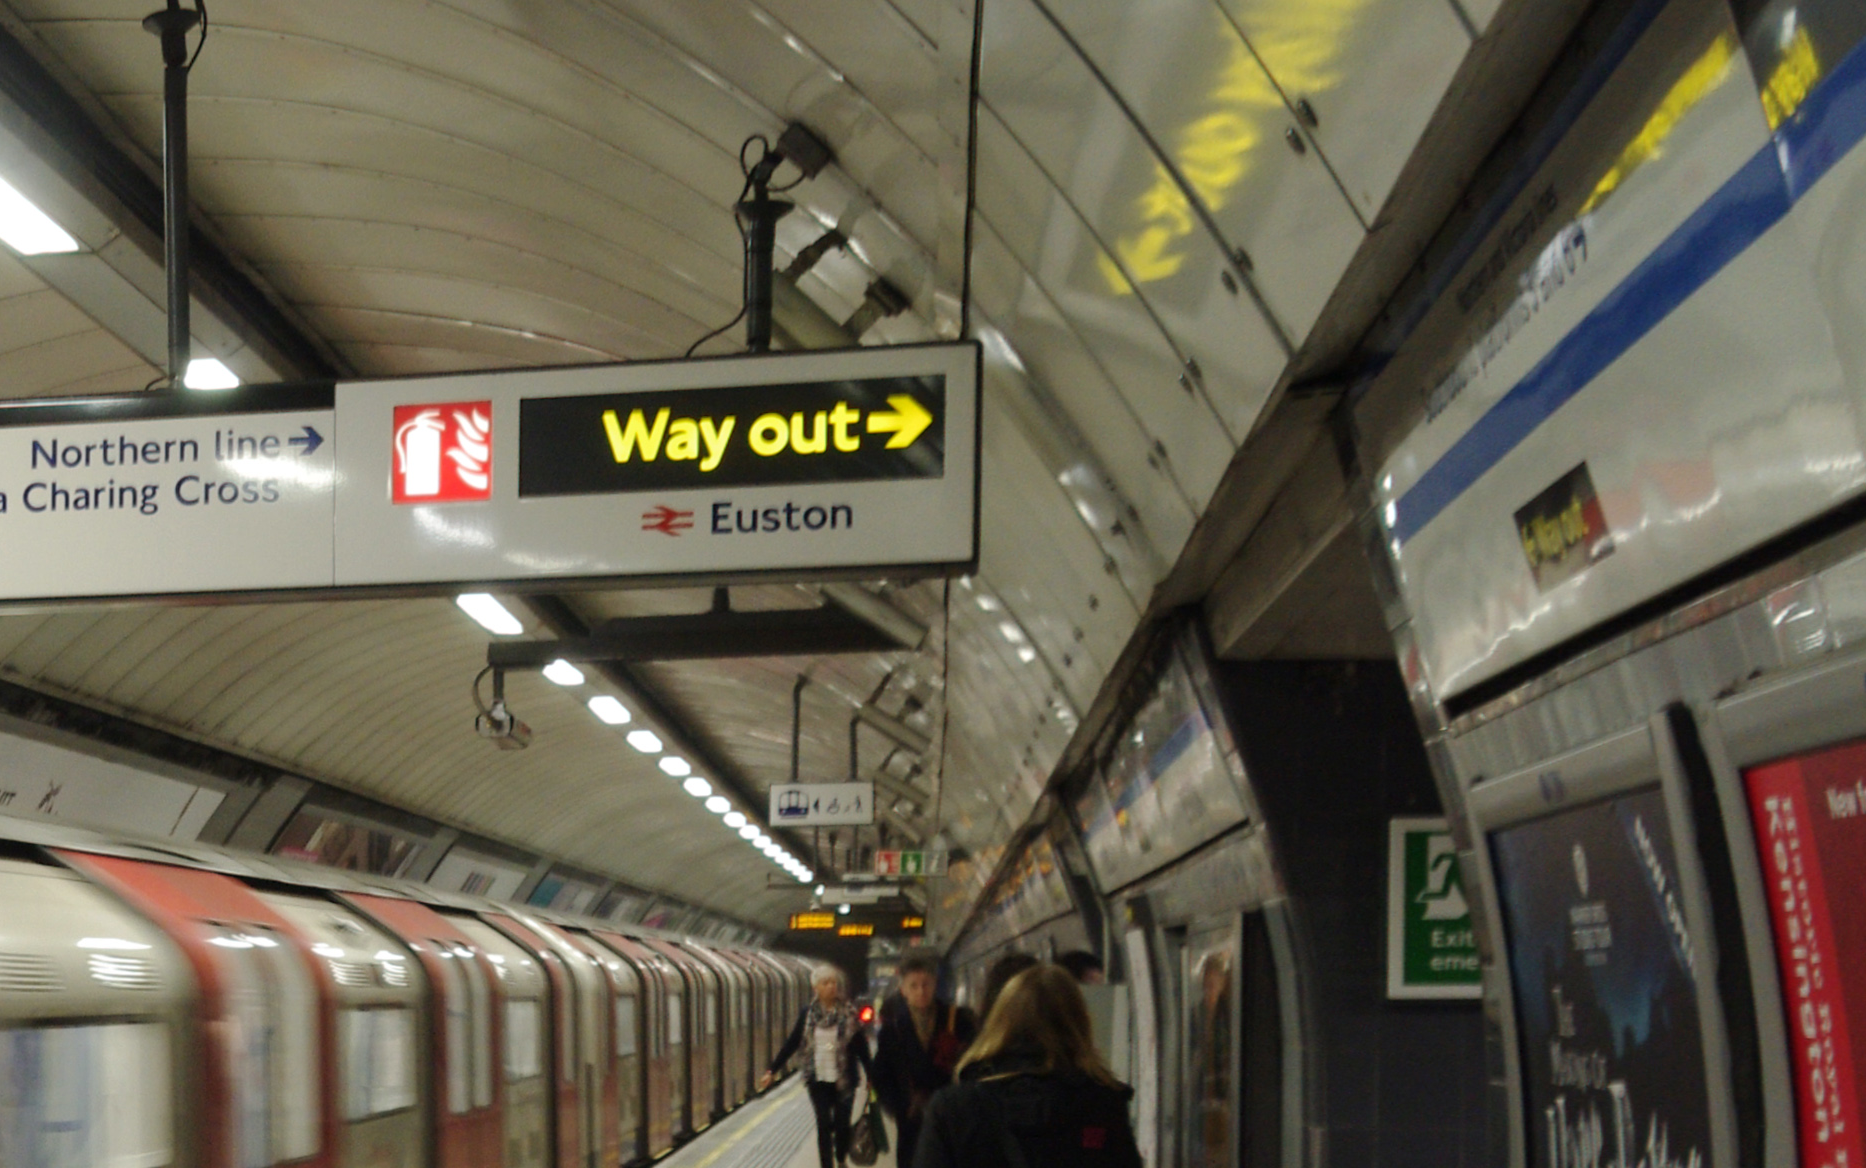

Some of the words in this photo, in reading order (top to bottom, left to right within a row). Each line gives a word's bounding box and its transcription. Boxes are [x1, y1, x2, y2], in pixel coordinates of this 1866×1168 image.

[31, 436, 199, 469] Northern
[214, 430, 281, 461] line
[601, 406, 736, 472] Way
[748, 402, 860, 456] out
[22, 479, 159, 515] Charing
[174, 475, 280, 506] Cross
[711, 501, 853, 534] Euston
[1431, 930, 1475, 948] Exit
[1764, 795, 1830, 1143] Kensington
[1782, 797, 1823, 990] Historic
[1818, 1002, 1845, 1133] Royal
